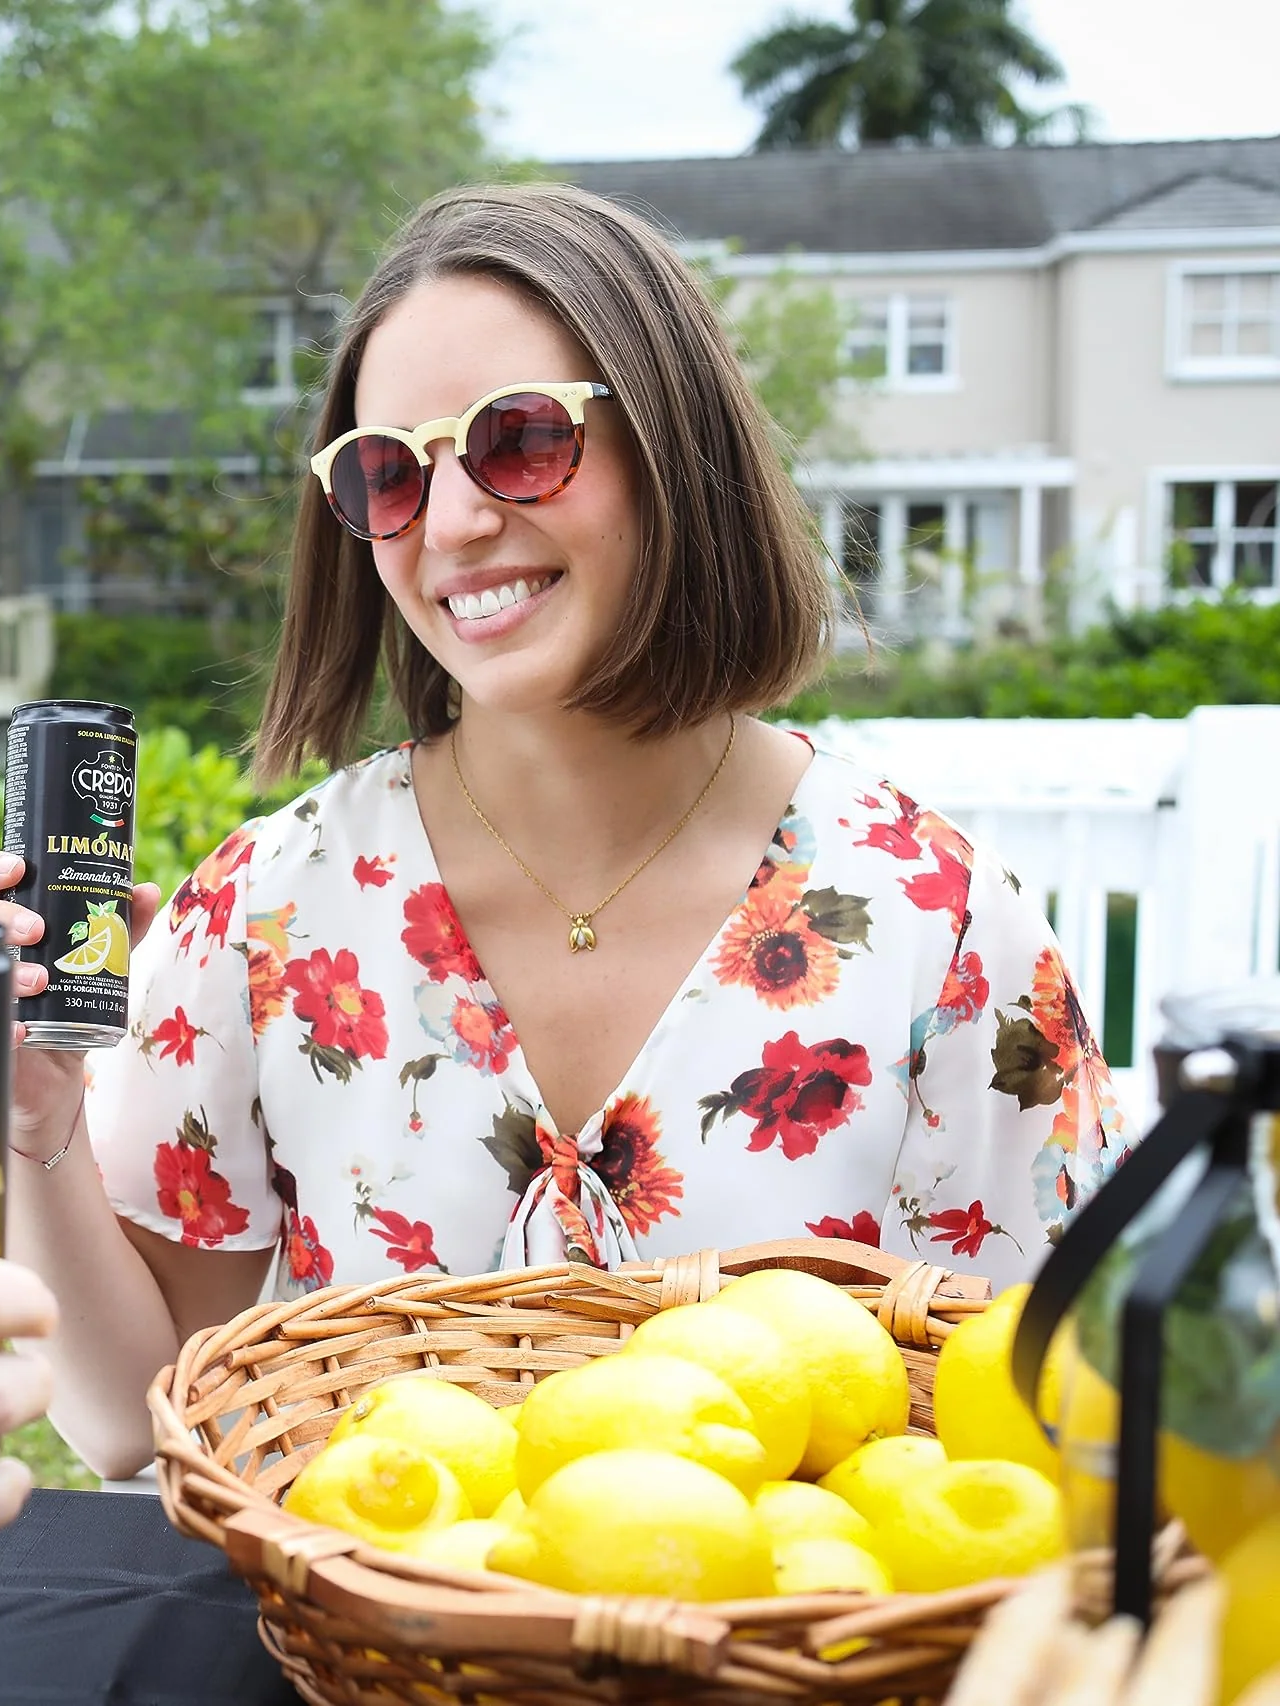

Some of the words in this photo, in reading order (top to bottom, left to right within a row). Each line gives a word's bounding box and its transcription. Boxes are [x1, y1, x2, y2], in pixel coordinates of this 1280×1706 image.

[77, 730, 95, 738] SOLO
[78, 768, 133, 798] CRODO
[102, 800, 118, 810] 1931
[57, 866, 112, 885] Limonata
[47, 884, 62, 892] CON
[62, 884, 82, 893] POLPA
[89, 887, 110, 896] LIMONE
[43, 984, 62, 992] QUA
[72, 986, 104, 995] SORGENTE
[64, 997, 83, 1008] 330
[83, 1000, 98, 1009] mL
